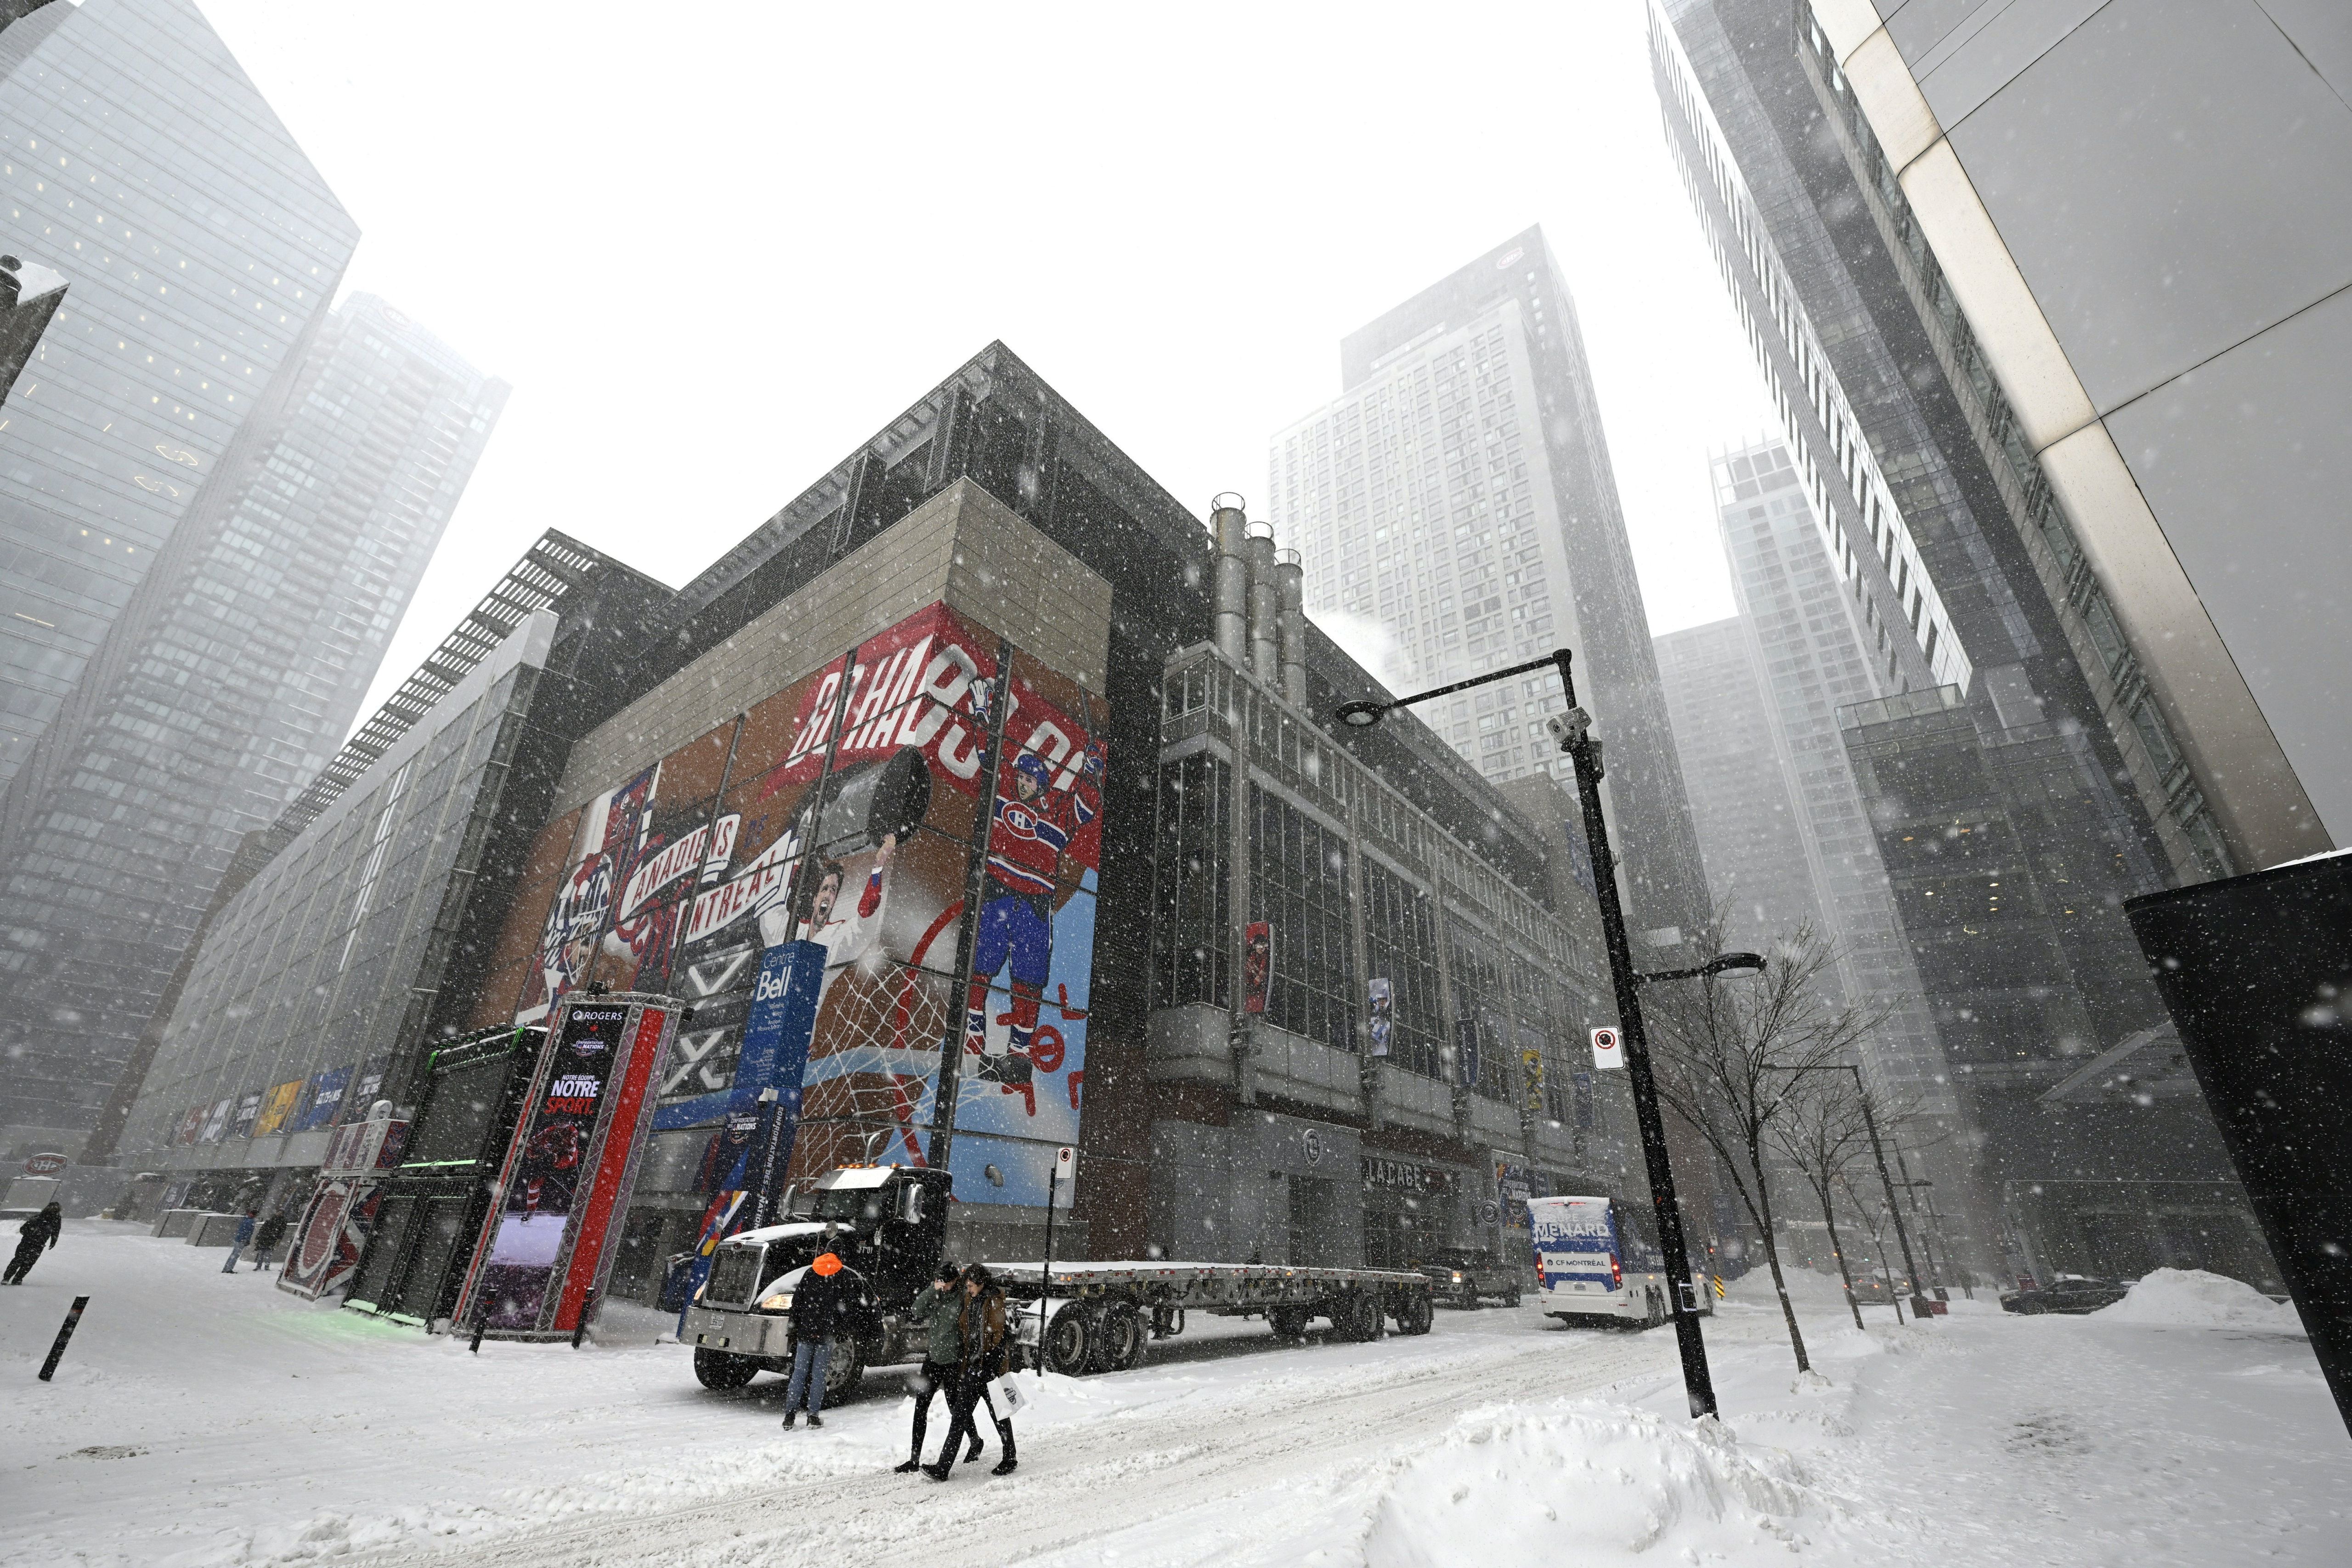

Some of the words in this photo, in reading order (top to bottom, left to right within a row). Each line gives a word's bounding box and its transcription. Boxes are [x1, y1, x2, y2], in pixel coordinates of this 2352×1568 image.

[764, 952, 795, 968] Centre
[756, 965, 792, 1002] Bell
[584, 1012, 623, 1020] ROGERS
[551, 1080, 600, 1097] NOTRE
[544, 1097, 594, 1115] SPORT.
[766, 1106, 784, 1169] CONFRONTATION
[763, 1169, 771, 1185] DES
[1387, 1162, 1420, 1188] CAGE
